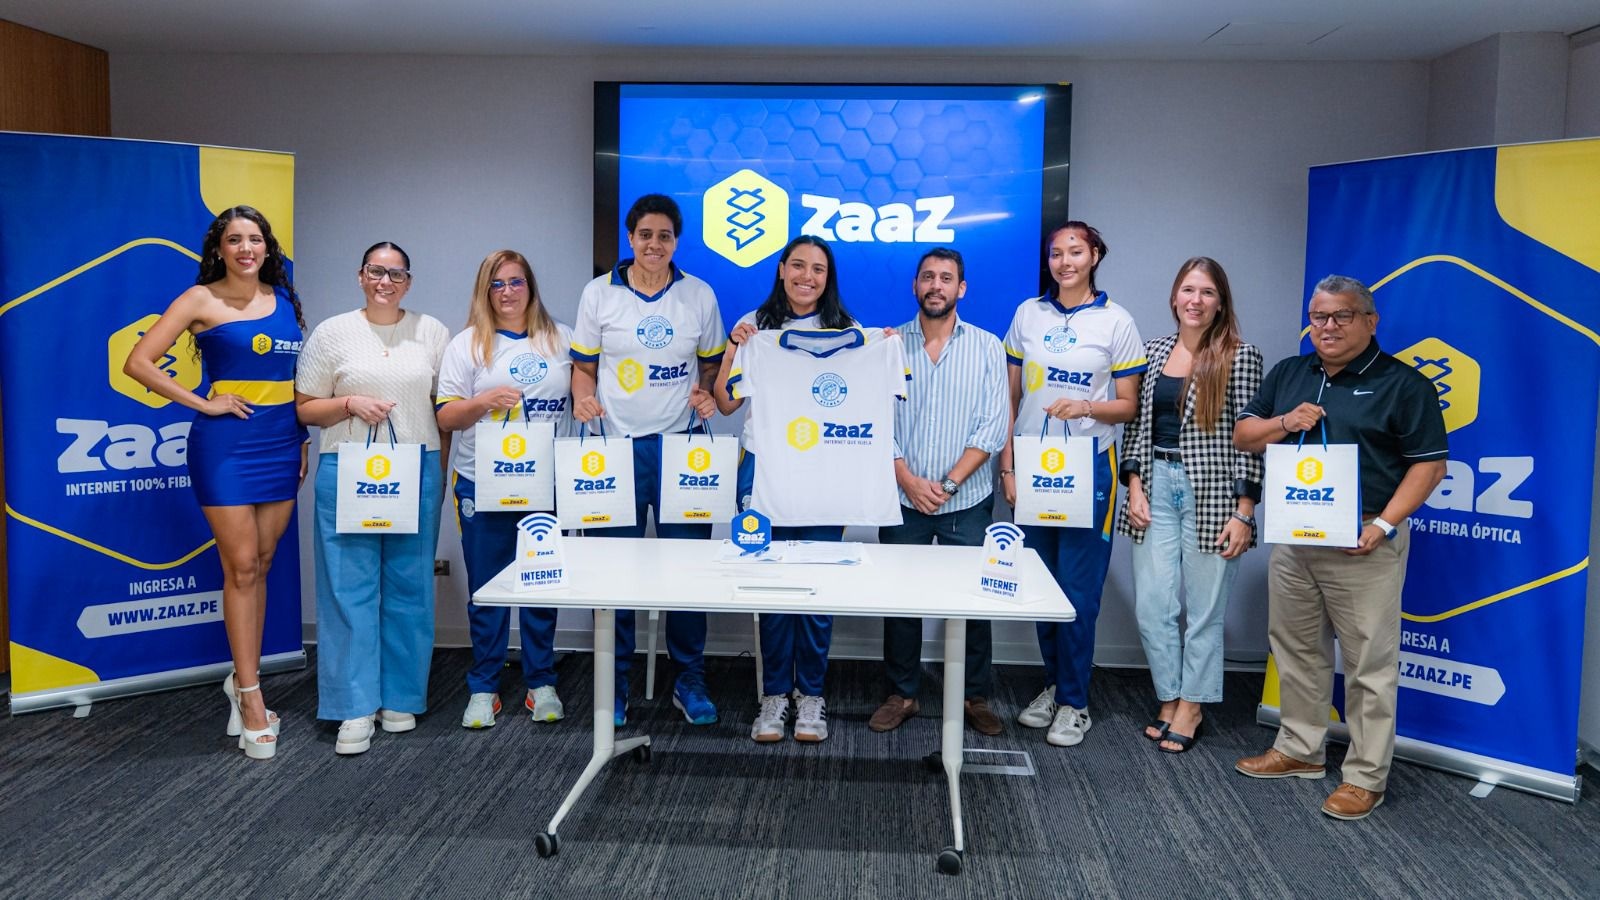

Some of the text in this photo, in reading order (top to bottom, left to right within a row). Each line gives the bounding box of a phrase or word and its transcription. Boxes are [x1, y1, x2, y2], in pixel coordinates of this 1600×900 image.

[56, 417, 193, 474] Zaa
[66, 479, 127, 497] INTERNET
[130, 477, 165, 491] 100%
[1429, 520, 1469, 538] FIBRA
[1472, 522, 1522, 544] ÓPTICA
[129, 576, 196, 595] INGRESA A
[521, 569, 562, 581] INTERNET
[981, 577, 1018, 592] INTERNET
[108, 600, 218, 626] WWW.ZAAZ.PE
[1402, 630, 1450, 653] RESA A
